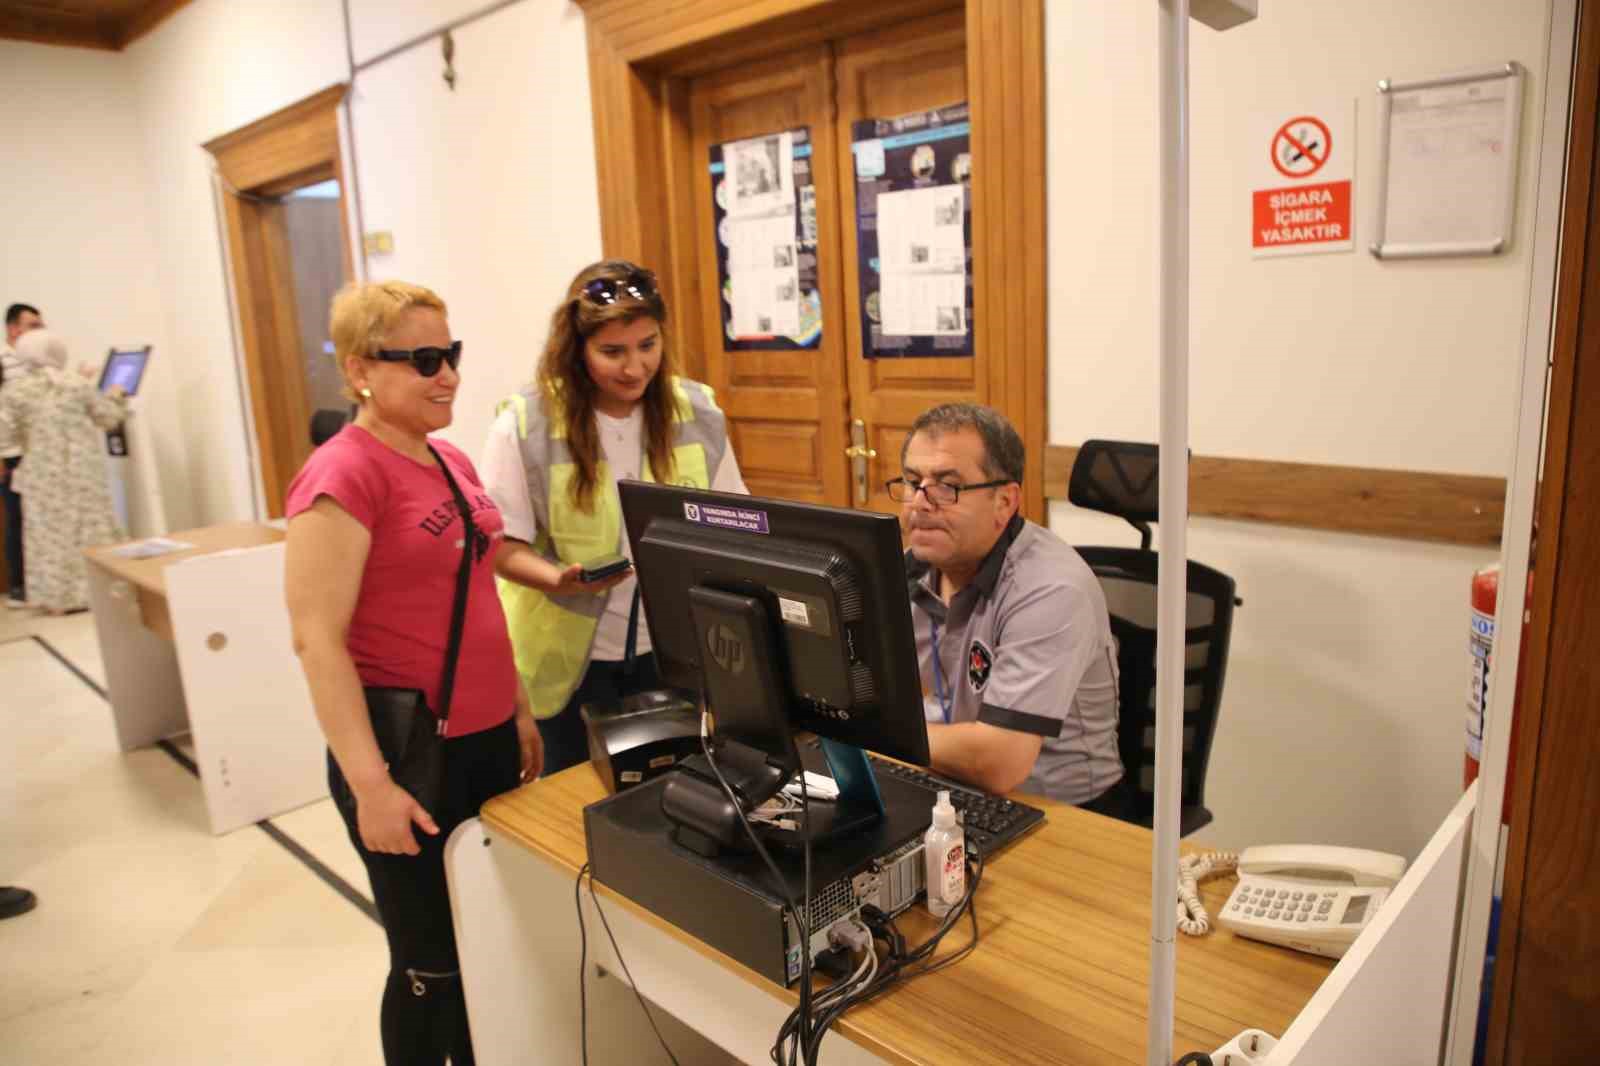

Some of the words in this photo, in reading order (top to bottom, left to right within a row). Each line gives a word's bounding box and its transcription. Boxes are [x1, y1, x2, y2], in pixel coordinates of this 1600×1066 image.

[1269, 190, 1333, 208] SİGARA
[1275, 206, 1327, 226] İÇMEK
[1261, 224, 1342, 243] YASAKTIR
